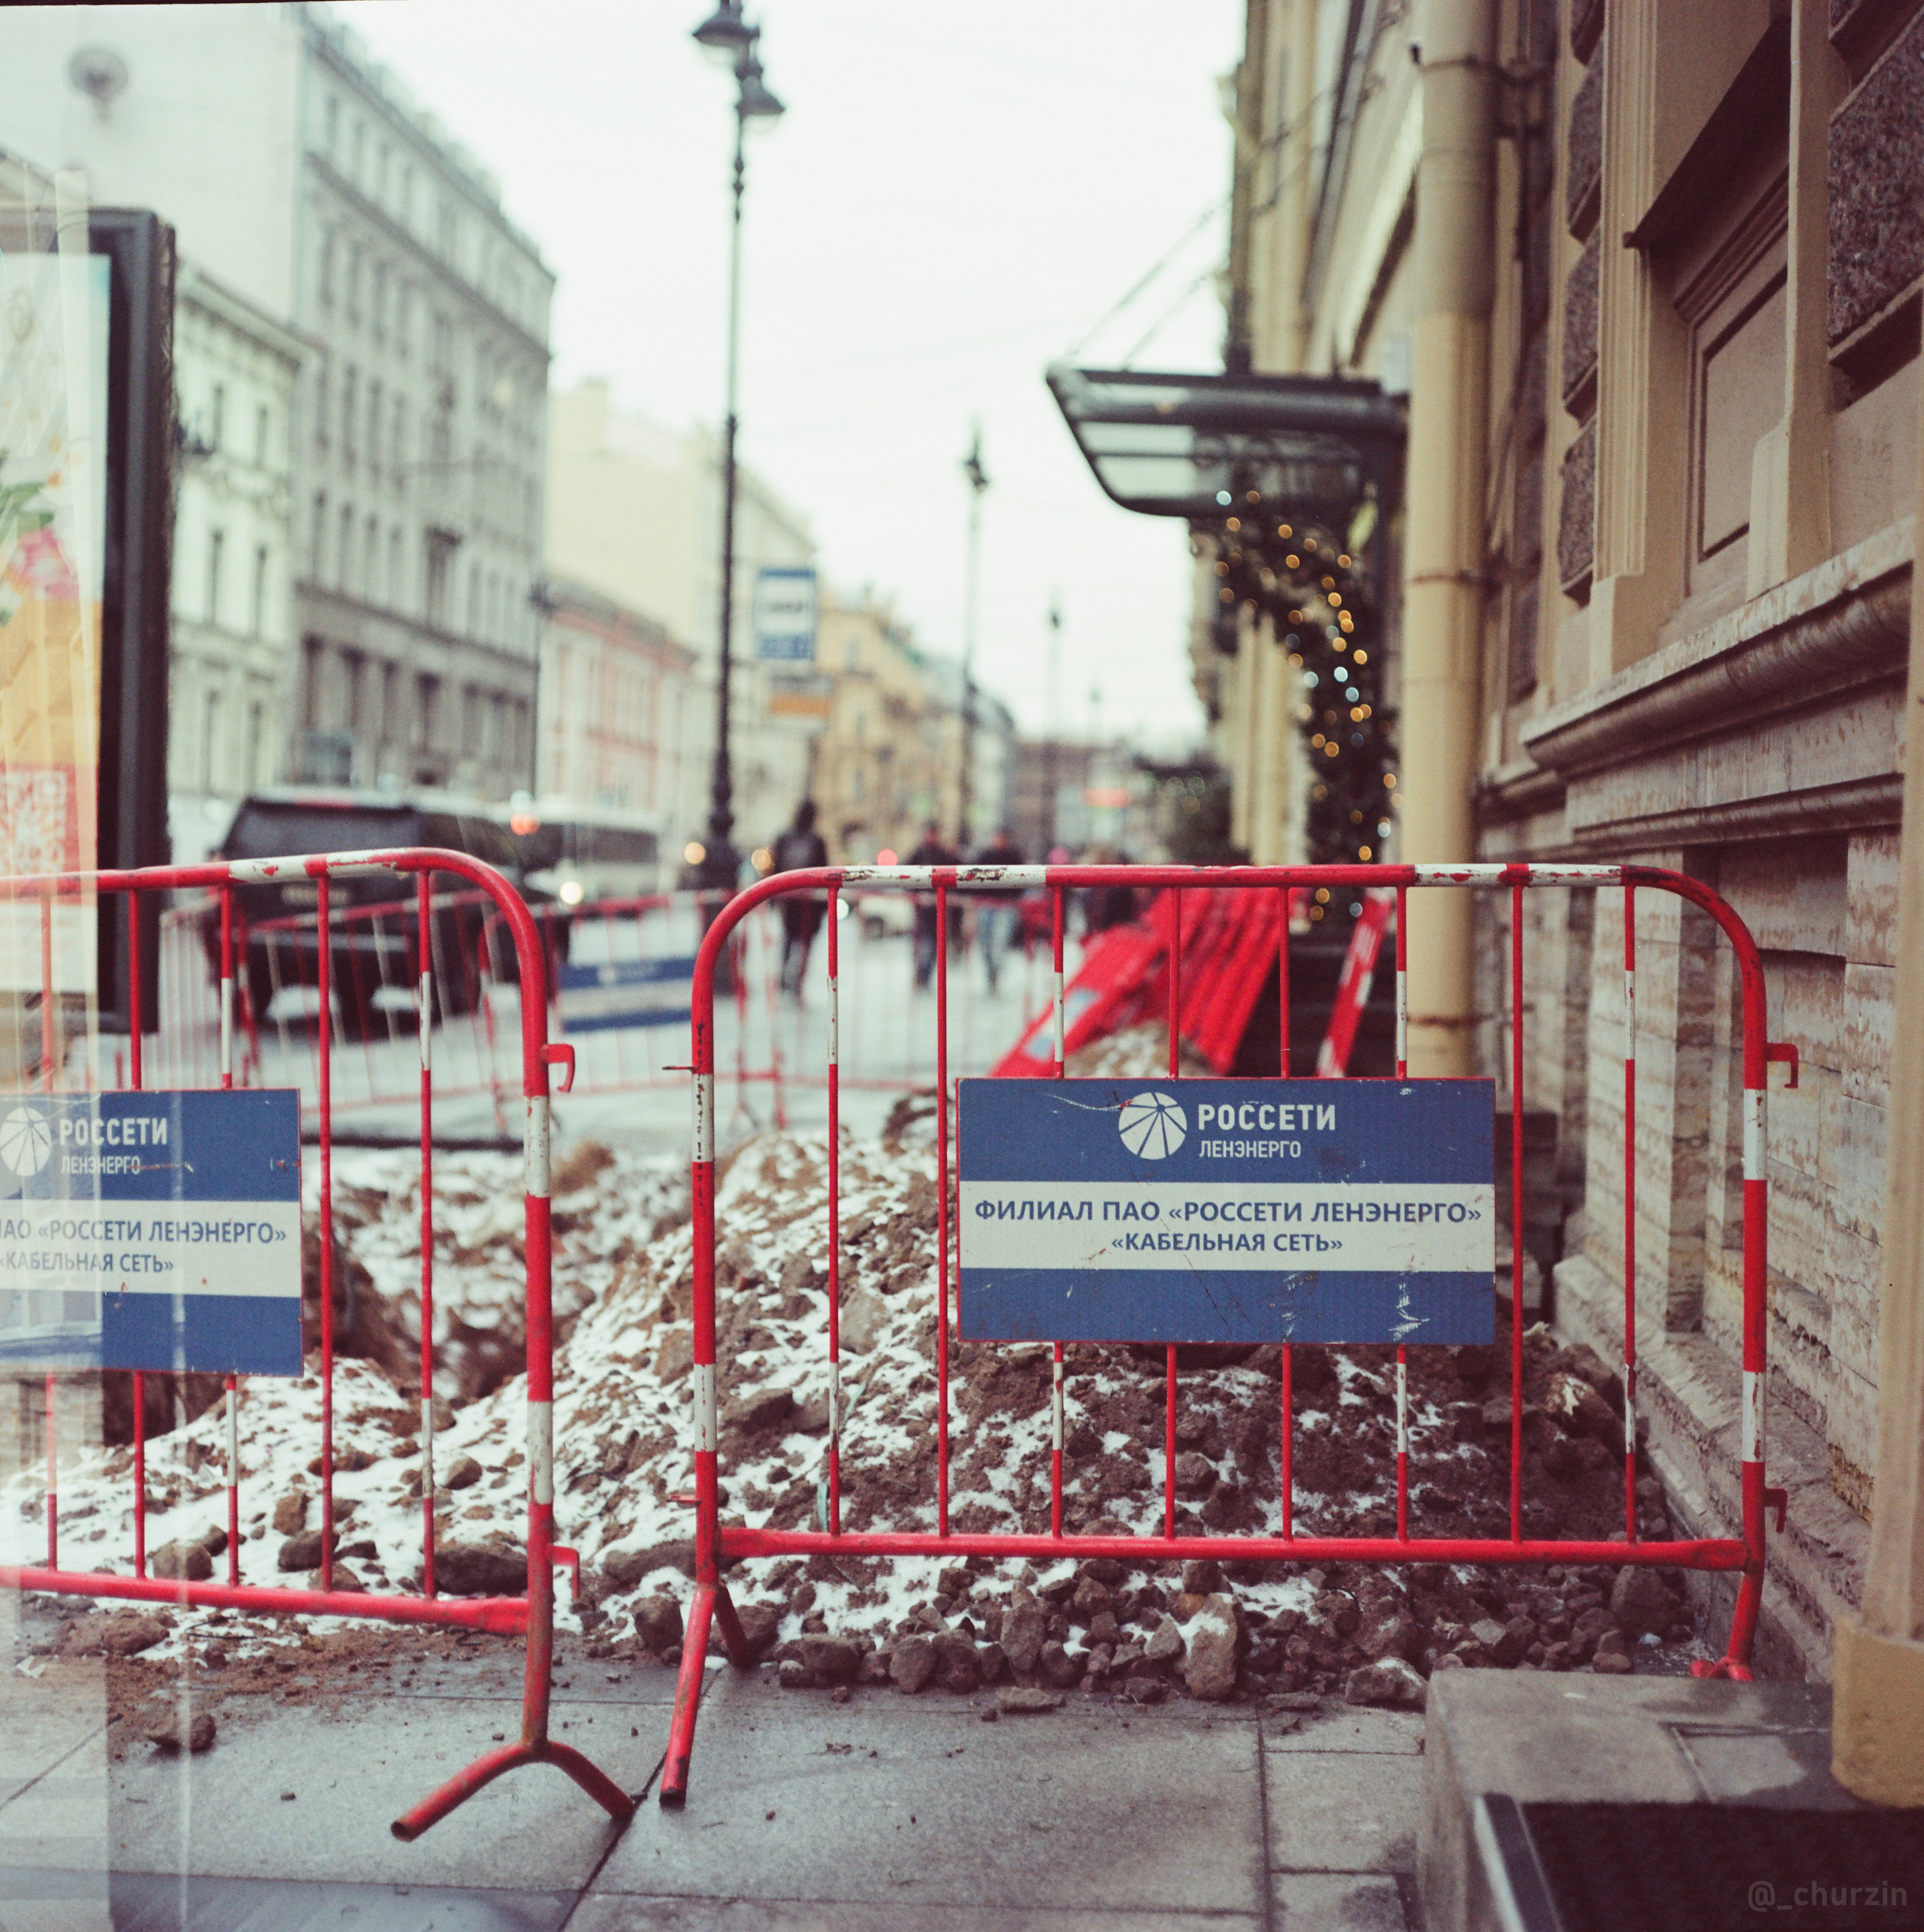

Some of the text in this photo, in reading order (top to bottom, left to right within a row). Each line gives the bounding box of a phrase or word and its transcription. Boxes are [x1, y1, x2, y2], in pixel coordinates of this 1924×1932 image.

[1198, 1104, 1336, 1132] РОССЕТИ
[59, 1117, 168, 1146] РОССЕТИ
[1199, 1140, 1302, 1159] ЛЕНЭНЕРГО
[61, 1155, 141, 1175] ЛЕНЭНЕРГО
[975, 1200, 1482, 1224] ФИЛИАЛ ПАО «РОССЕТИ ЛЕНЭНЕРГО»
[0, 1219, 287, 1243] АО «РОССЕТИ ЛЕНЭНЕРГО»
[1111, 1231, 1344, 1253] «КАБЕЛЬНАЯ СЕТЬ»
[119, 1253, 174, 1273] СЕТЬ»
